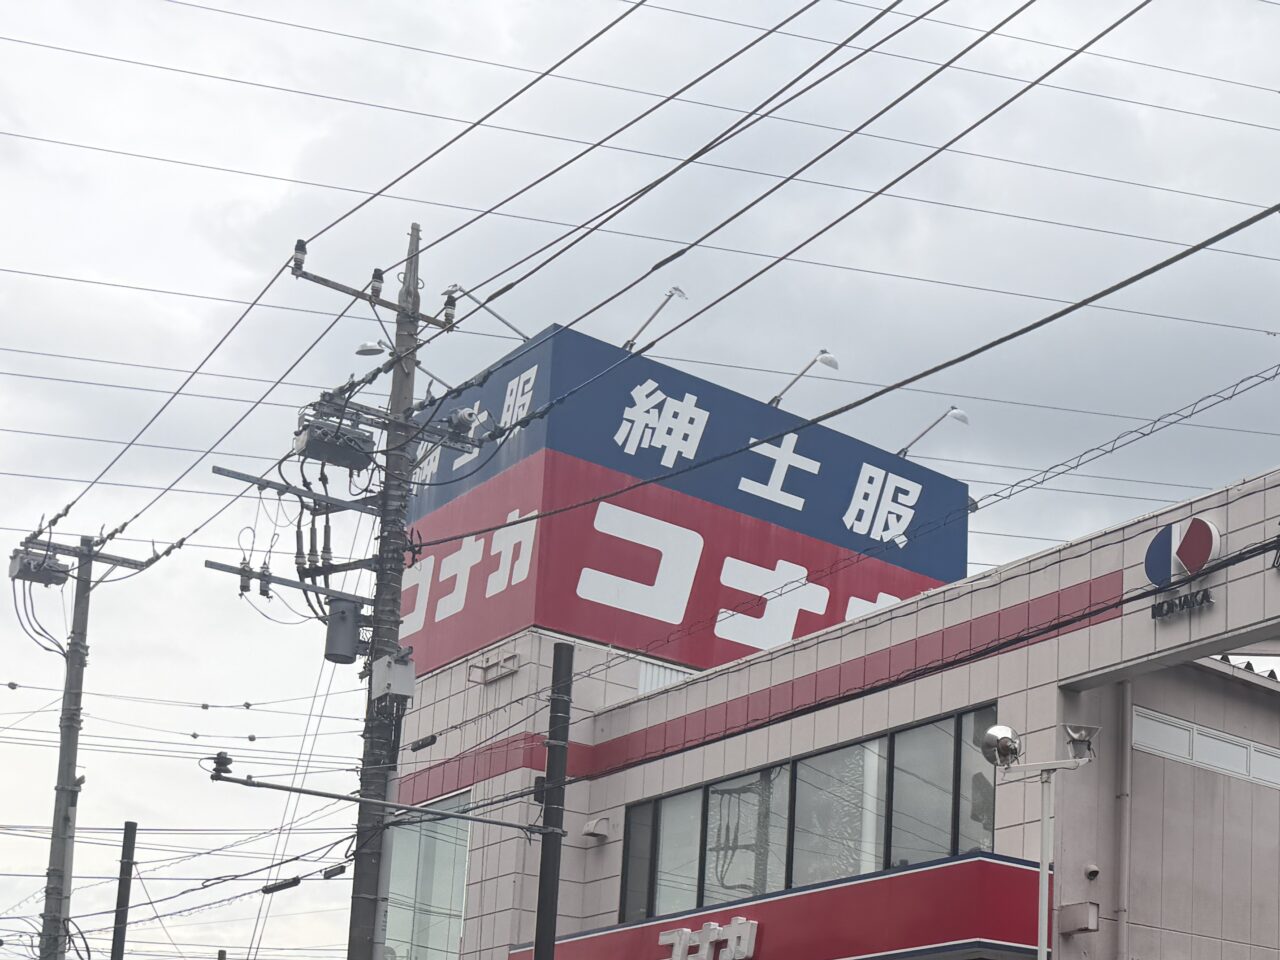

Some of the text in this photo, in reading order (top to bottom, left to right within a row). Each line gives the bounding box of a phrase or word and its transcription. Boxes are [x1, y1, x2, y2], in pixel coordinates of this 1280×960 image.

[613, 378, 922, 549] 紳士服
[399, 509, 538, 639] コナカ
[576, 501, 902, 650] コナ
[1151, 589, 1215, 619] KONAKA
